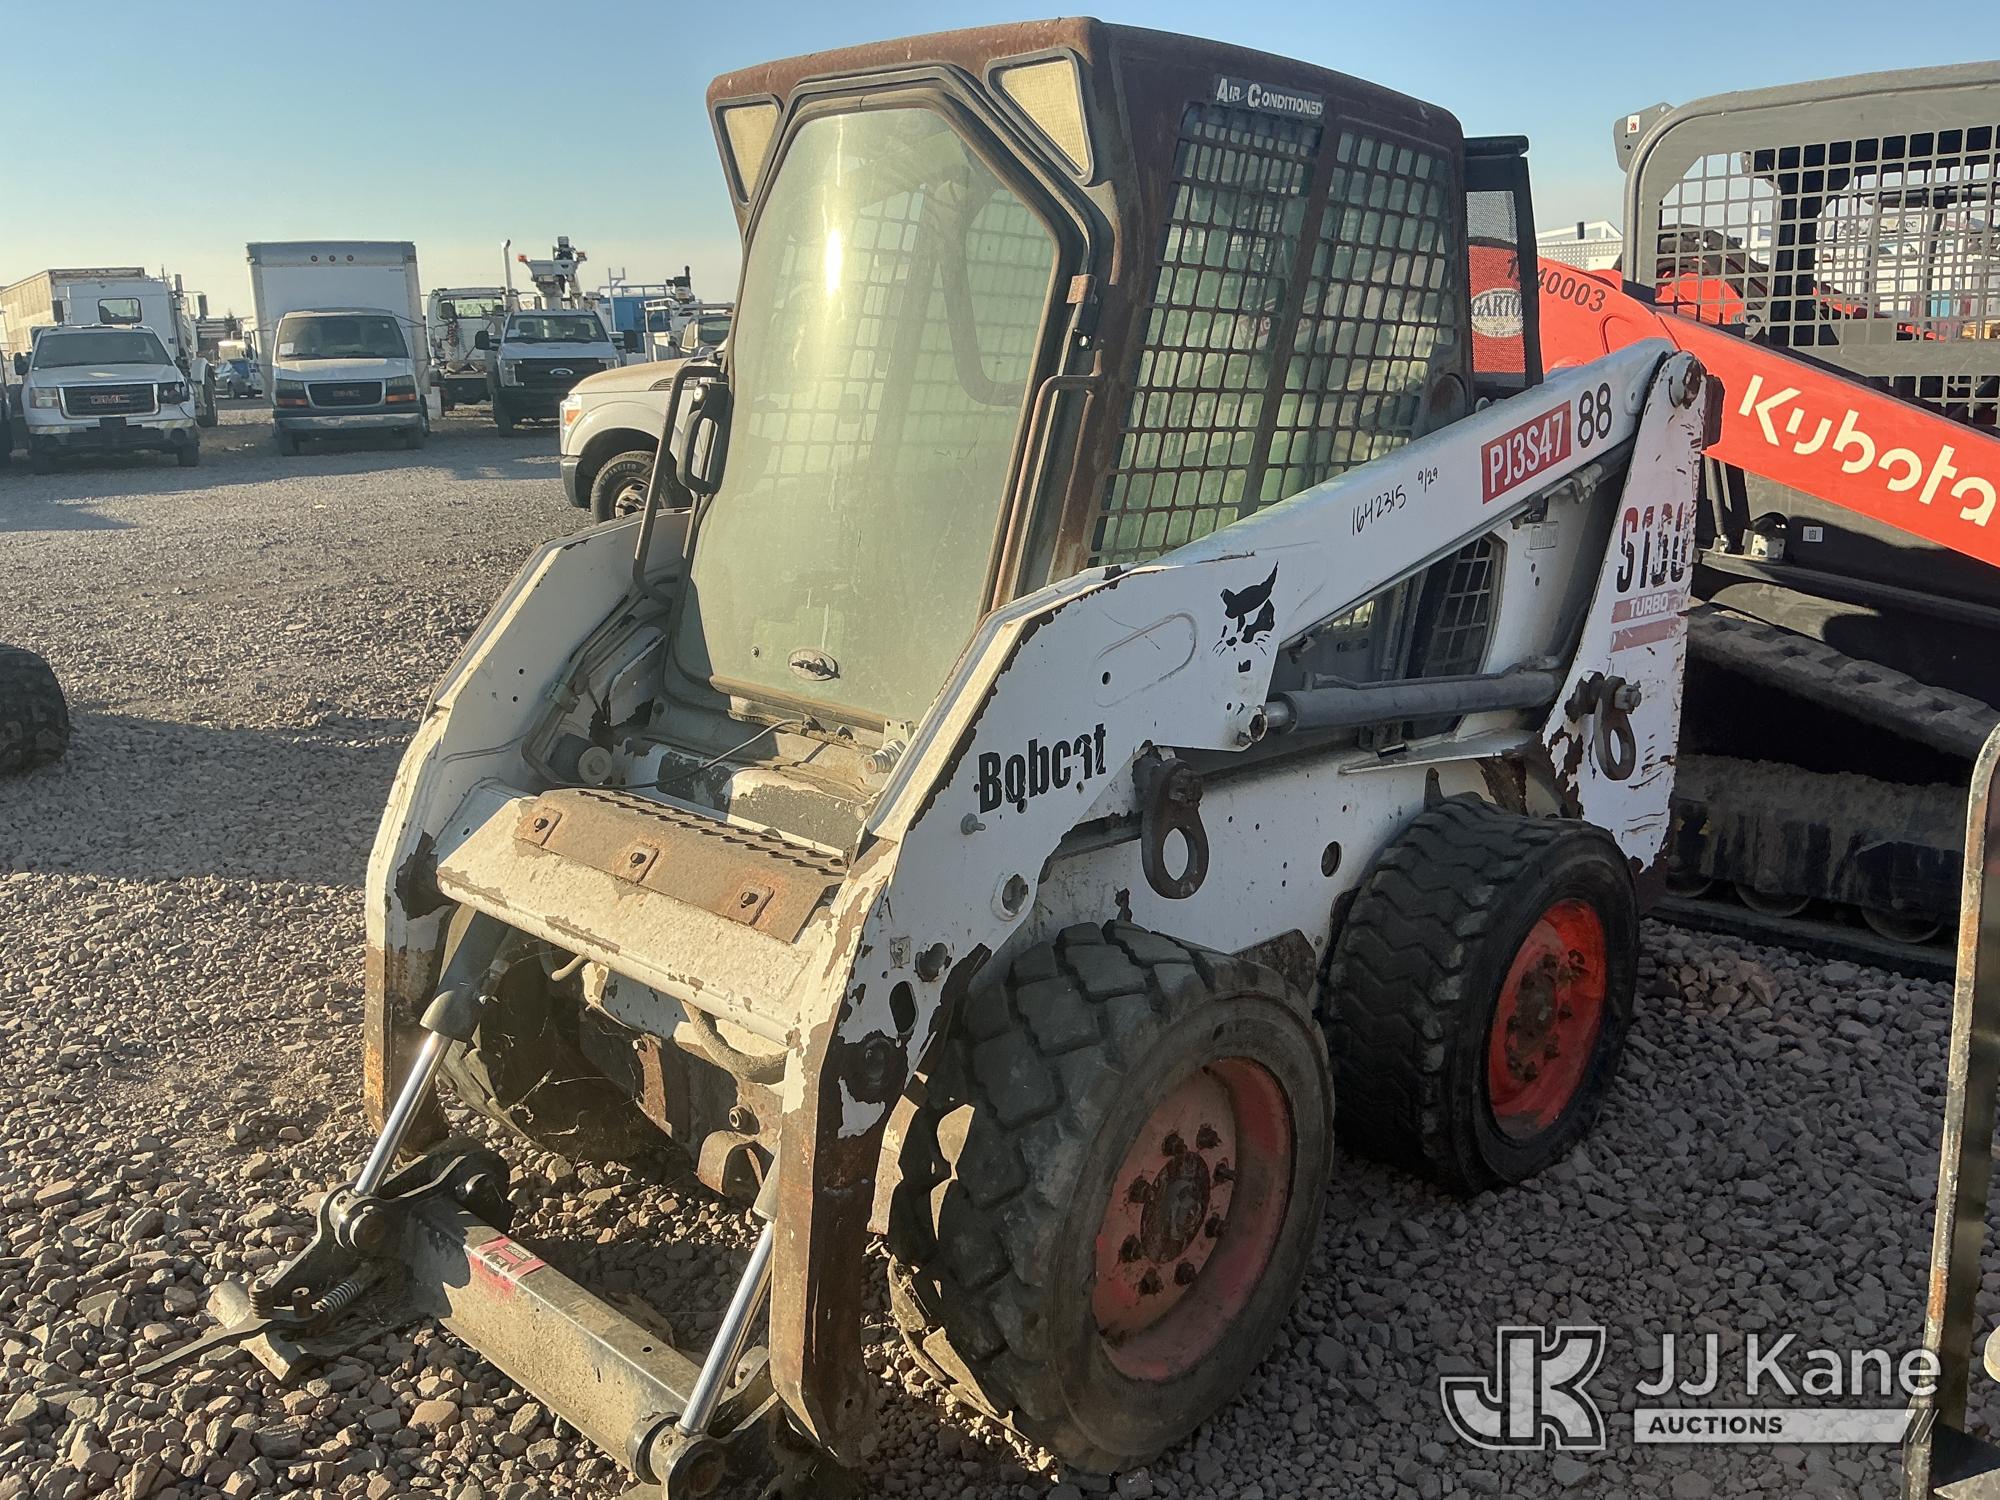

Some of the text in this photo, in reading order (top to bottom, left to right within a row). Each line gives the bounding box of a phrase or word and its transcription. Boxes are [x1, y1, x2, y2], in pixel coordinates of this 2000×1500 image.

[1472, 293, 1521, 318] GARTO
[1578, 383, 1612, 448] 88
[1490, 411, 1564, 493] PJ3S47
[1738, 374, 1997, 527] Kubota
[1352, 484, 1406, 536] 1642315
[1630, 592, 1669, 618] TURBO
[979, 723, 1106, 814] Bobcat
